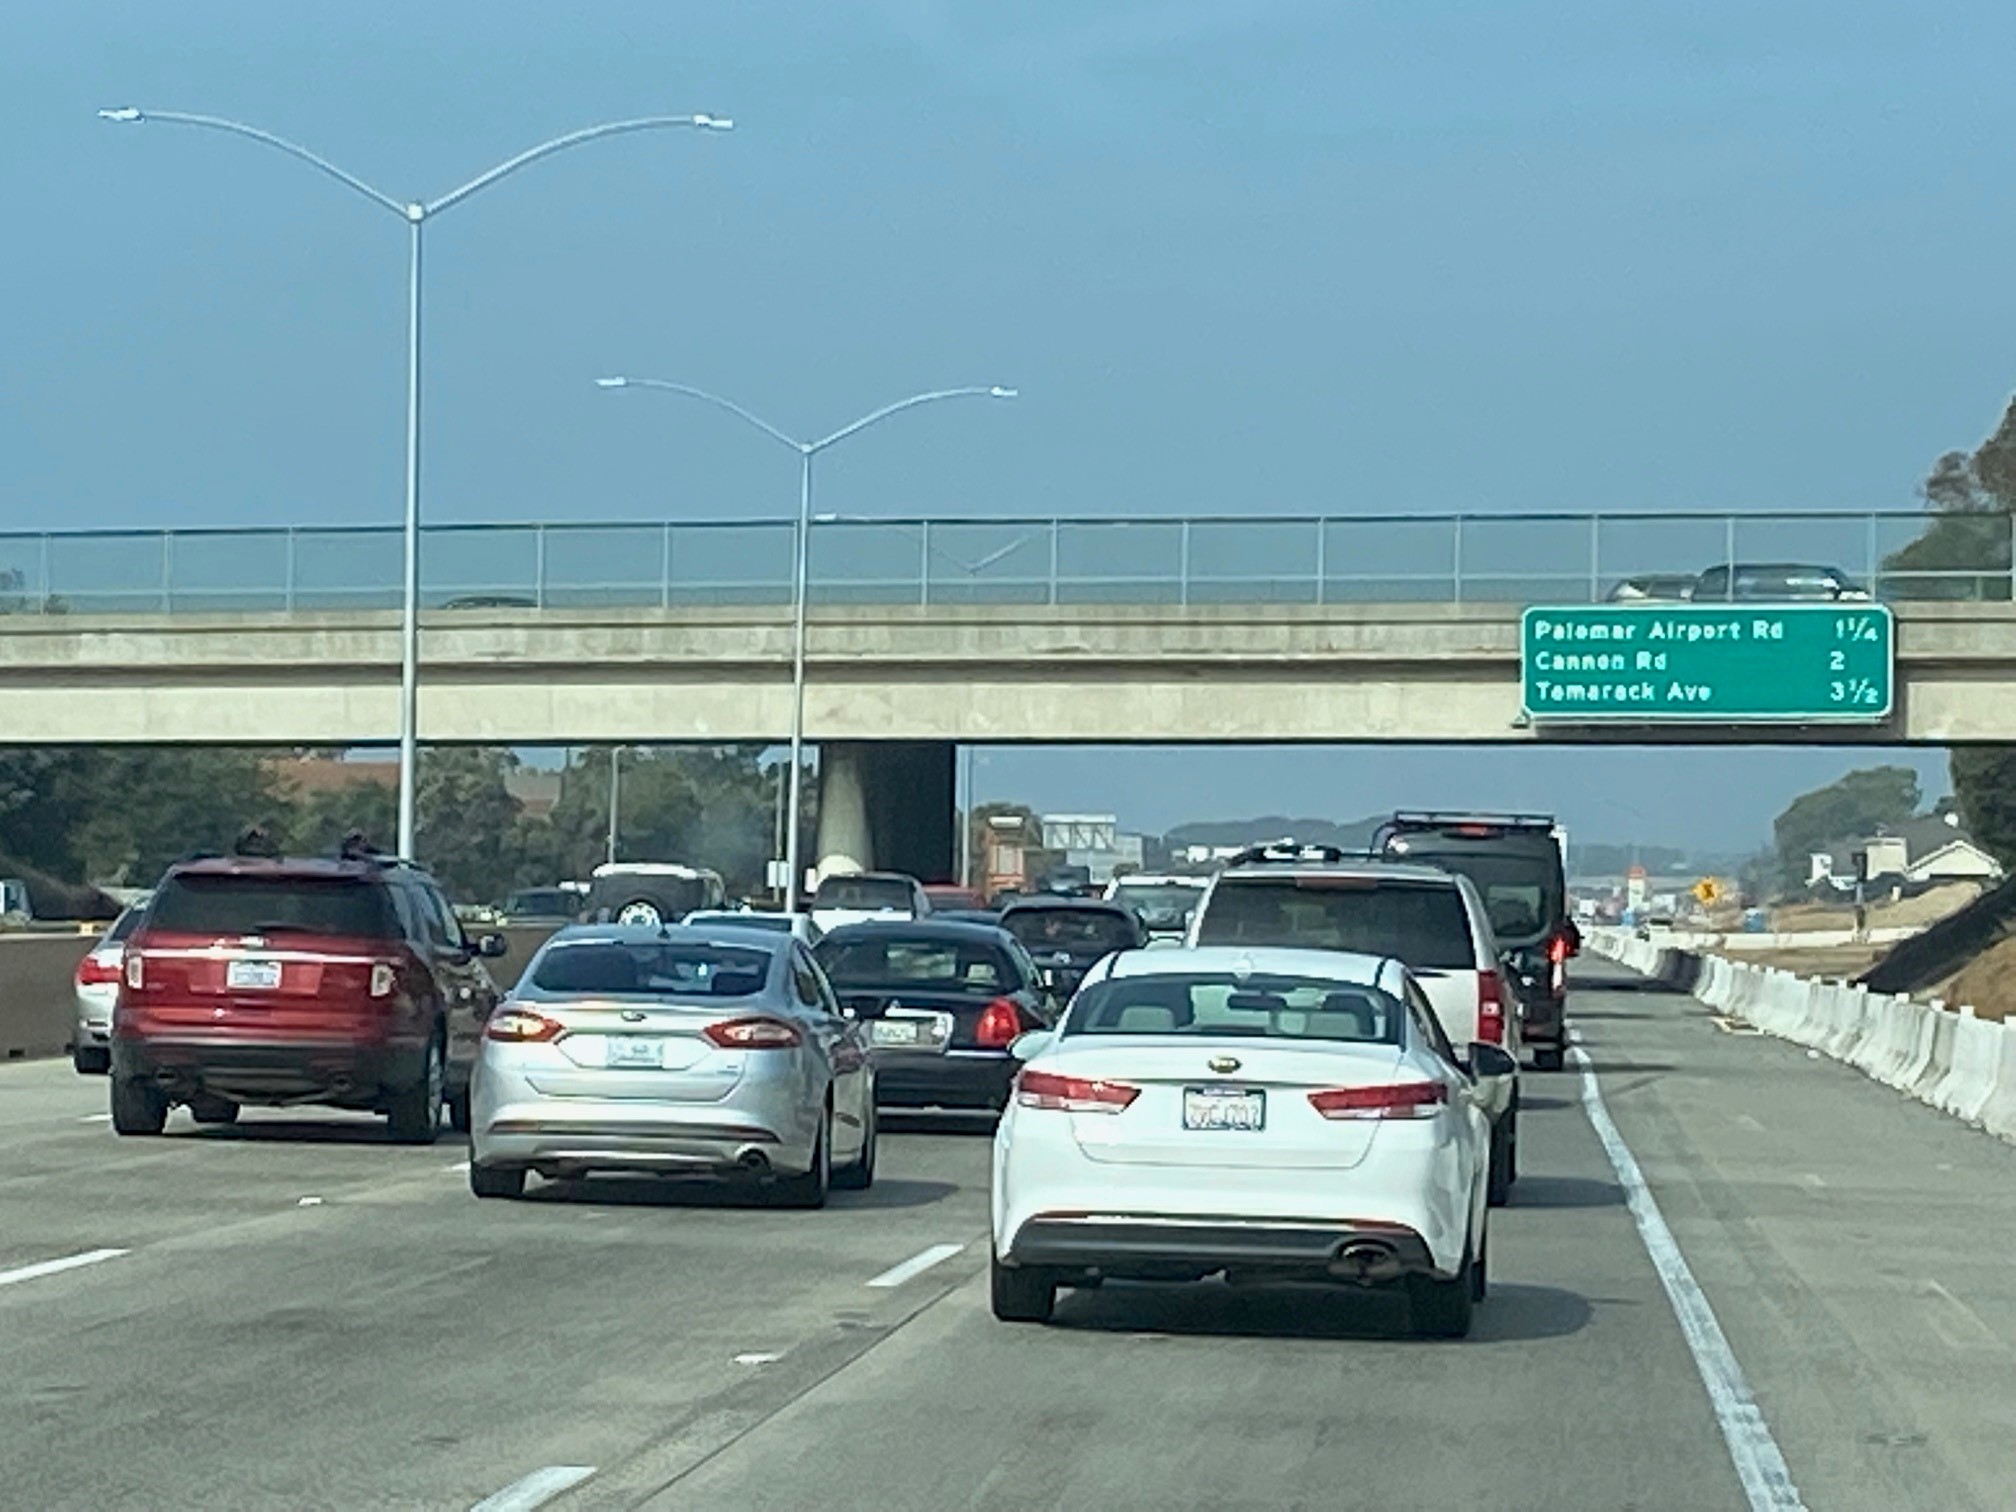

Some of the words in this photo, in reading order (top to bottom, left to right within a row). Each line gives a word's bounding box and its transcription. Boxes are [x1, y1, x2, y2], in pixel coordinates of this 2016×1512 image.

[1535, 620, 1637, 639] Palomar
[1648, 621, 1741, 641] Airport
[1752, 620, 1782, 639] Rd
[1535, 651, 1625, 670] Cannon
[1636, 651, 1666, 670] Rd
[1830, 651, 1845, 670] 2
[1667, 681, 1712, 701] Ave
